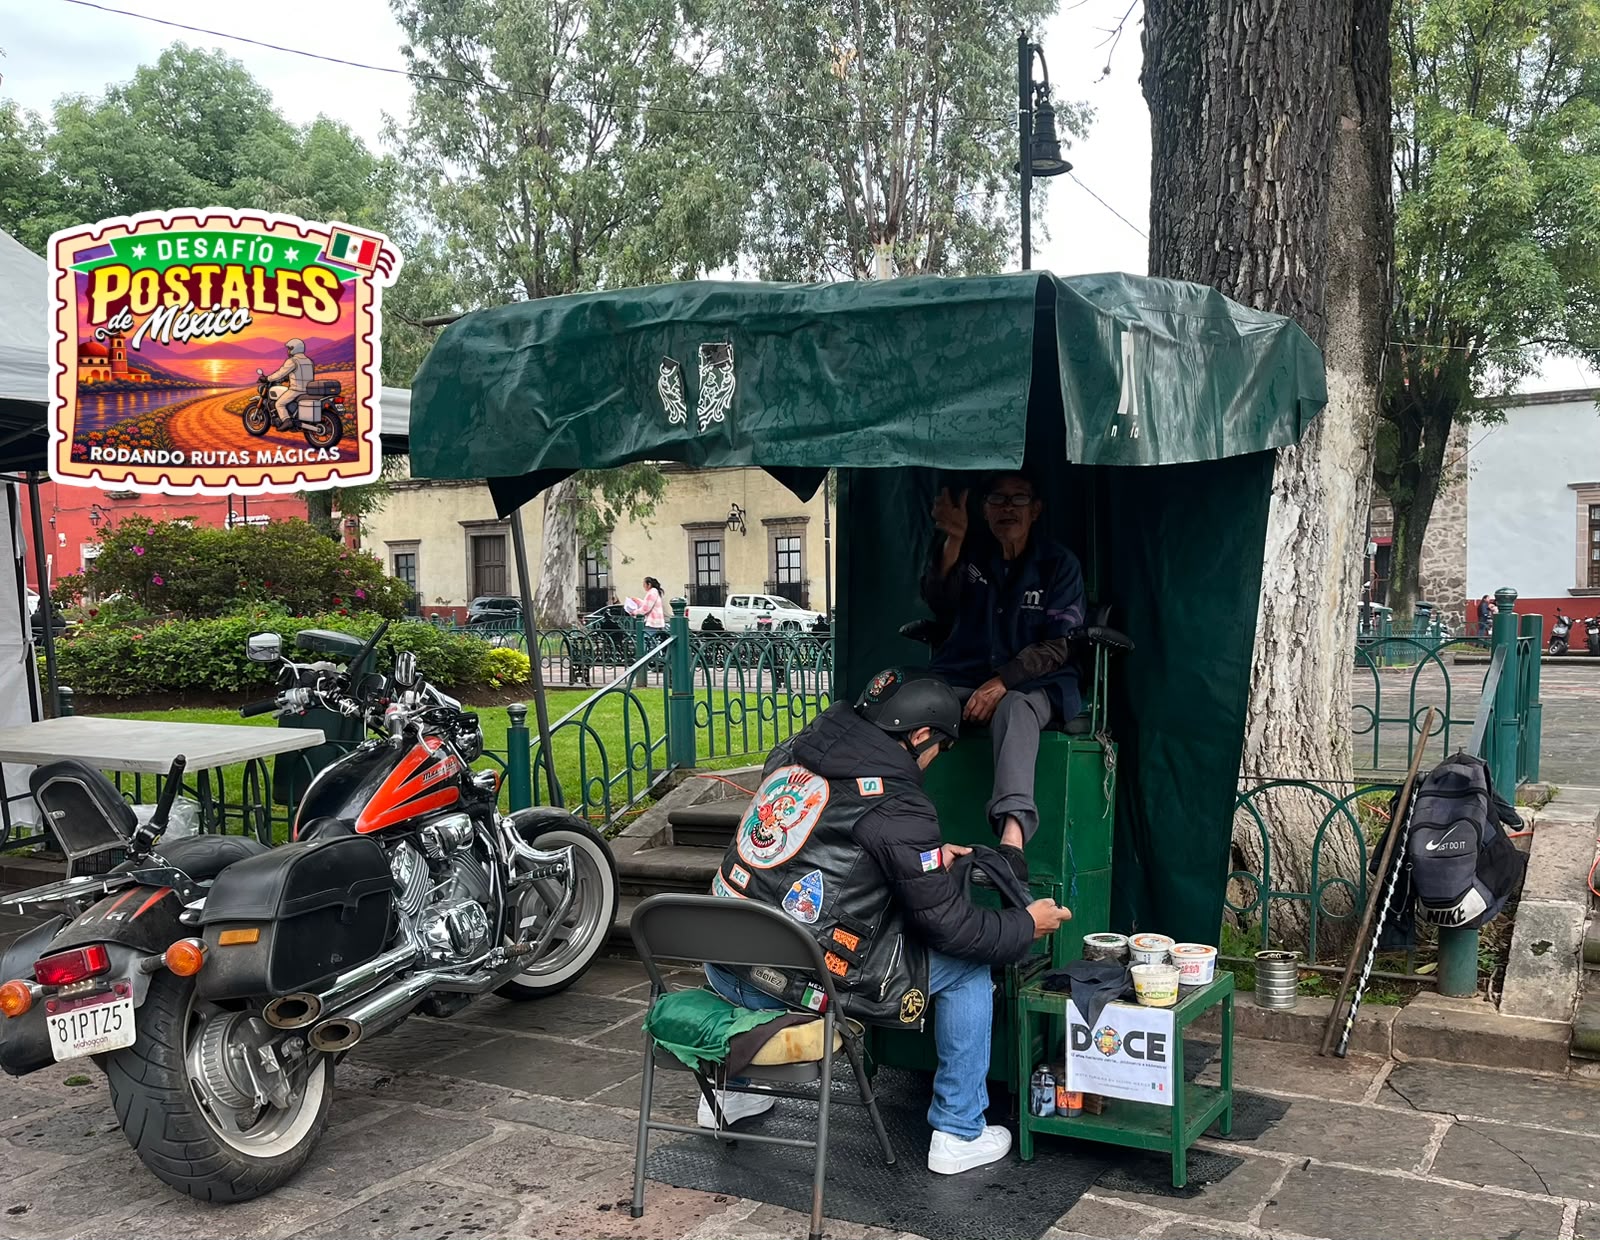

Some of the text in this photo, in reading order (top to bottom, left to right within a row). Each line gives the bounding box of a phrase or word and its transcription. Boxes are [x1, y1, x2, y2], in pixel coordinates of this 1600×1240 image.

[1426, 903, 1466, 925] NIKE
[807, 980, 825, 992] MEXI
[57, 1004, 122, 1043] 81PTZ5
